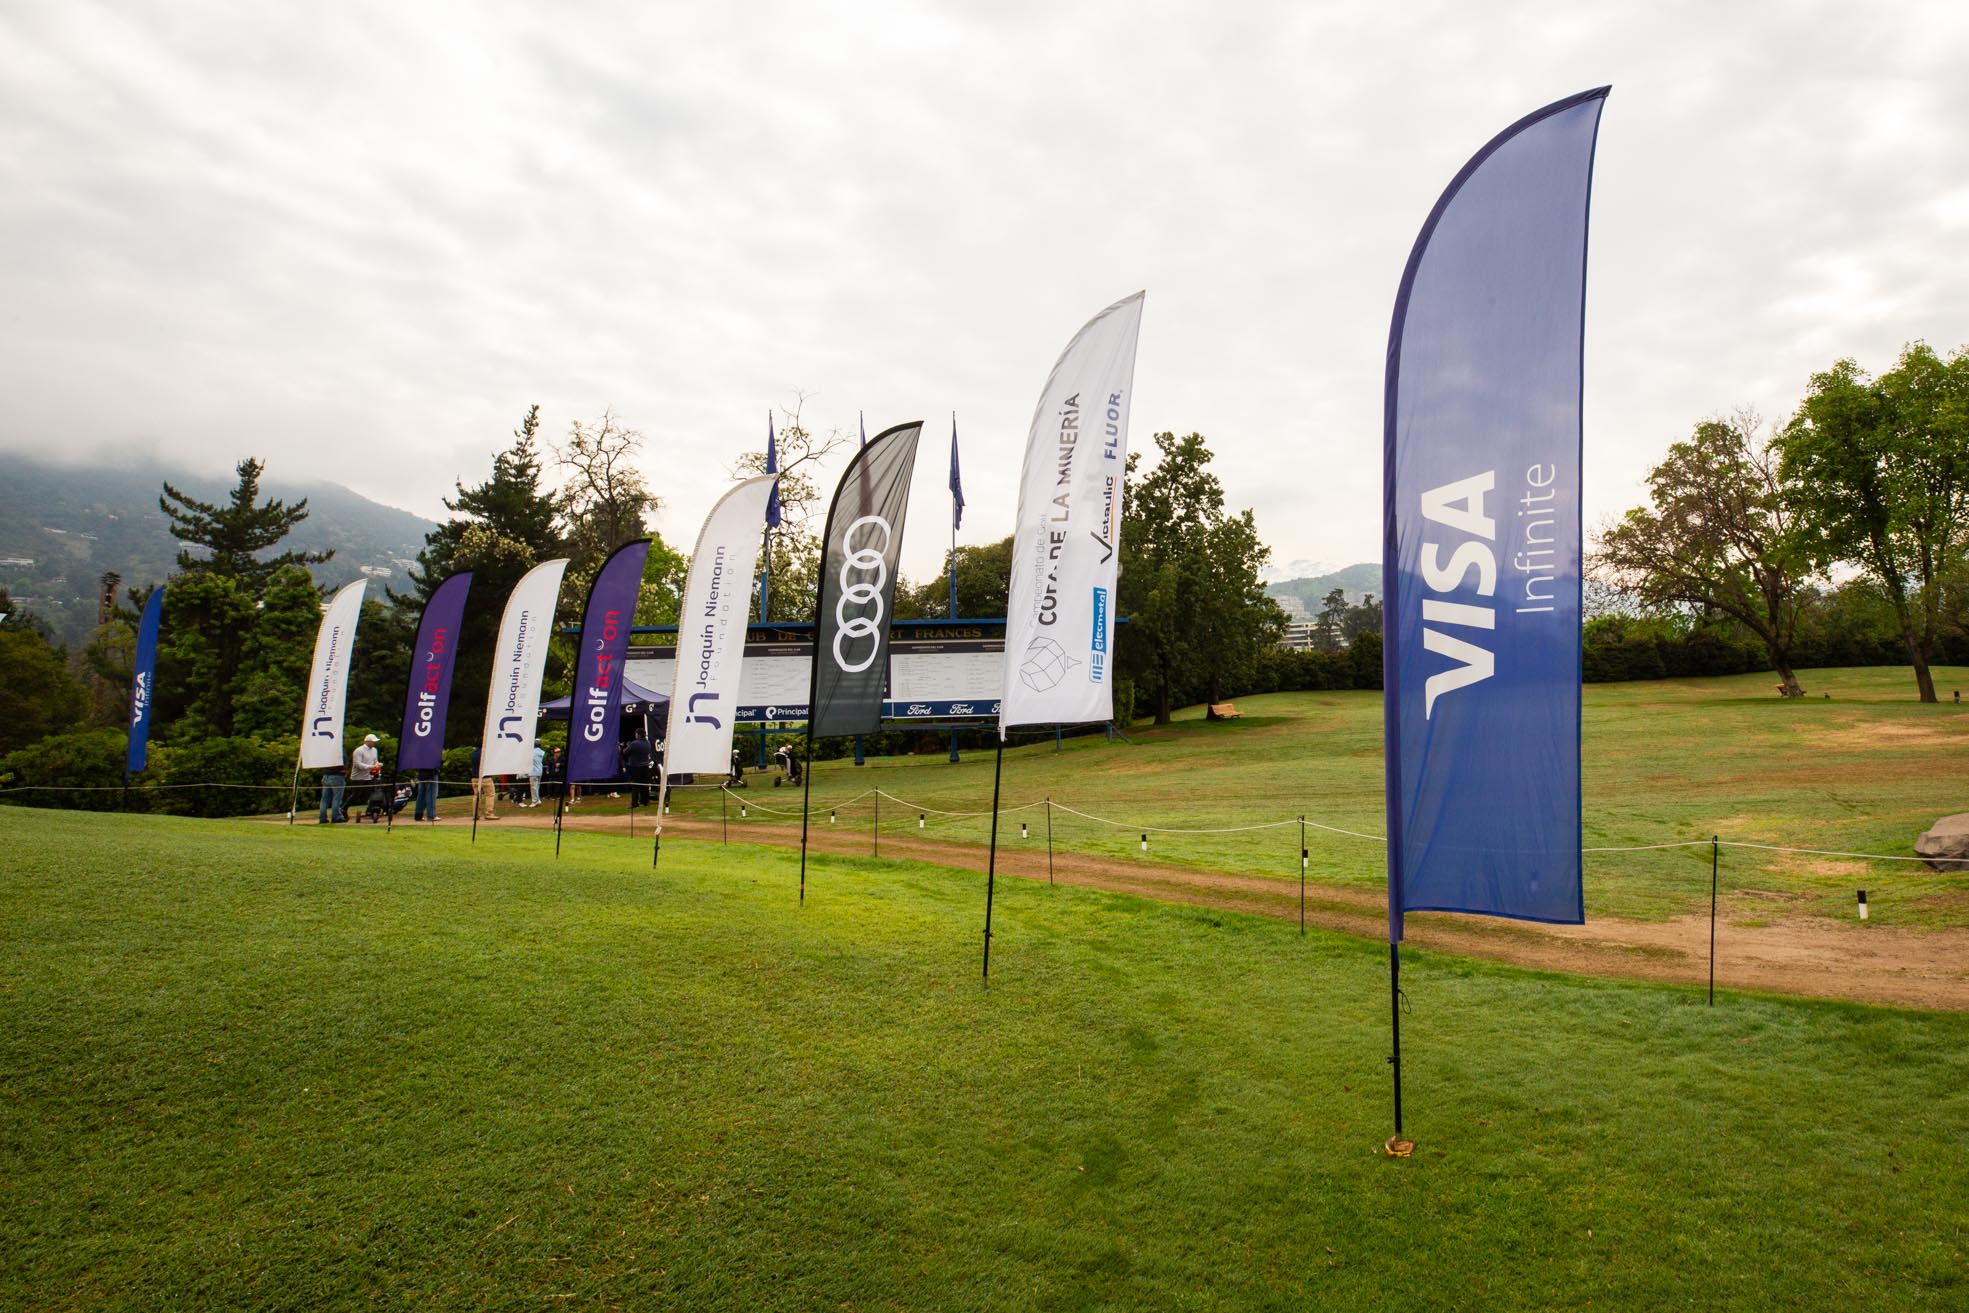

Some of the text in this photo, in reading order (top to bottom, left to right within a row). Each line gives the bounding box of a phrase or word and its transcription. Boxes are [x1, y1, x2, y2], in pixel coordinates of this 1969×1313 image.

[1104, 392, 1121, 460] FLUOR
[1051, 492, 1070, 522] LA
[1515, 463, 1555, 612] Infinite
[696, 546, 726, 690] Joaquin Niemann
[710, 553, 737, 682] Foundation
[1095, 590, 1107, 650] elecmetal
[1421, 470, 1496, 720] VISA
[505, 610, 529, 714] Joaquin Niemann
[133, 672, 146, 728] VISA
[735, 708, 755, 718] cipal
[777, 708, 809, 717] Principal
[907, 704, 932, 715] Ford
[949, 703, 974, 714] Ford
